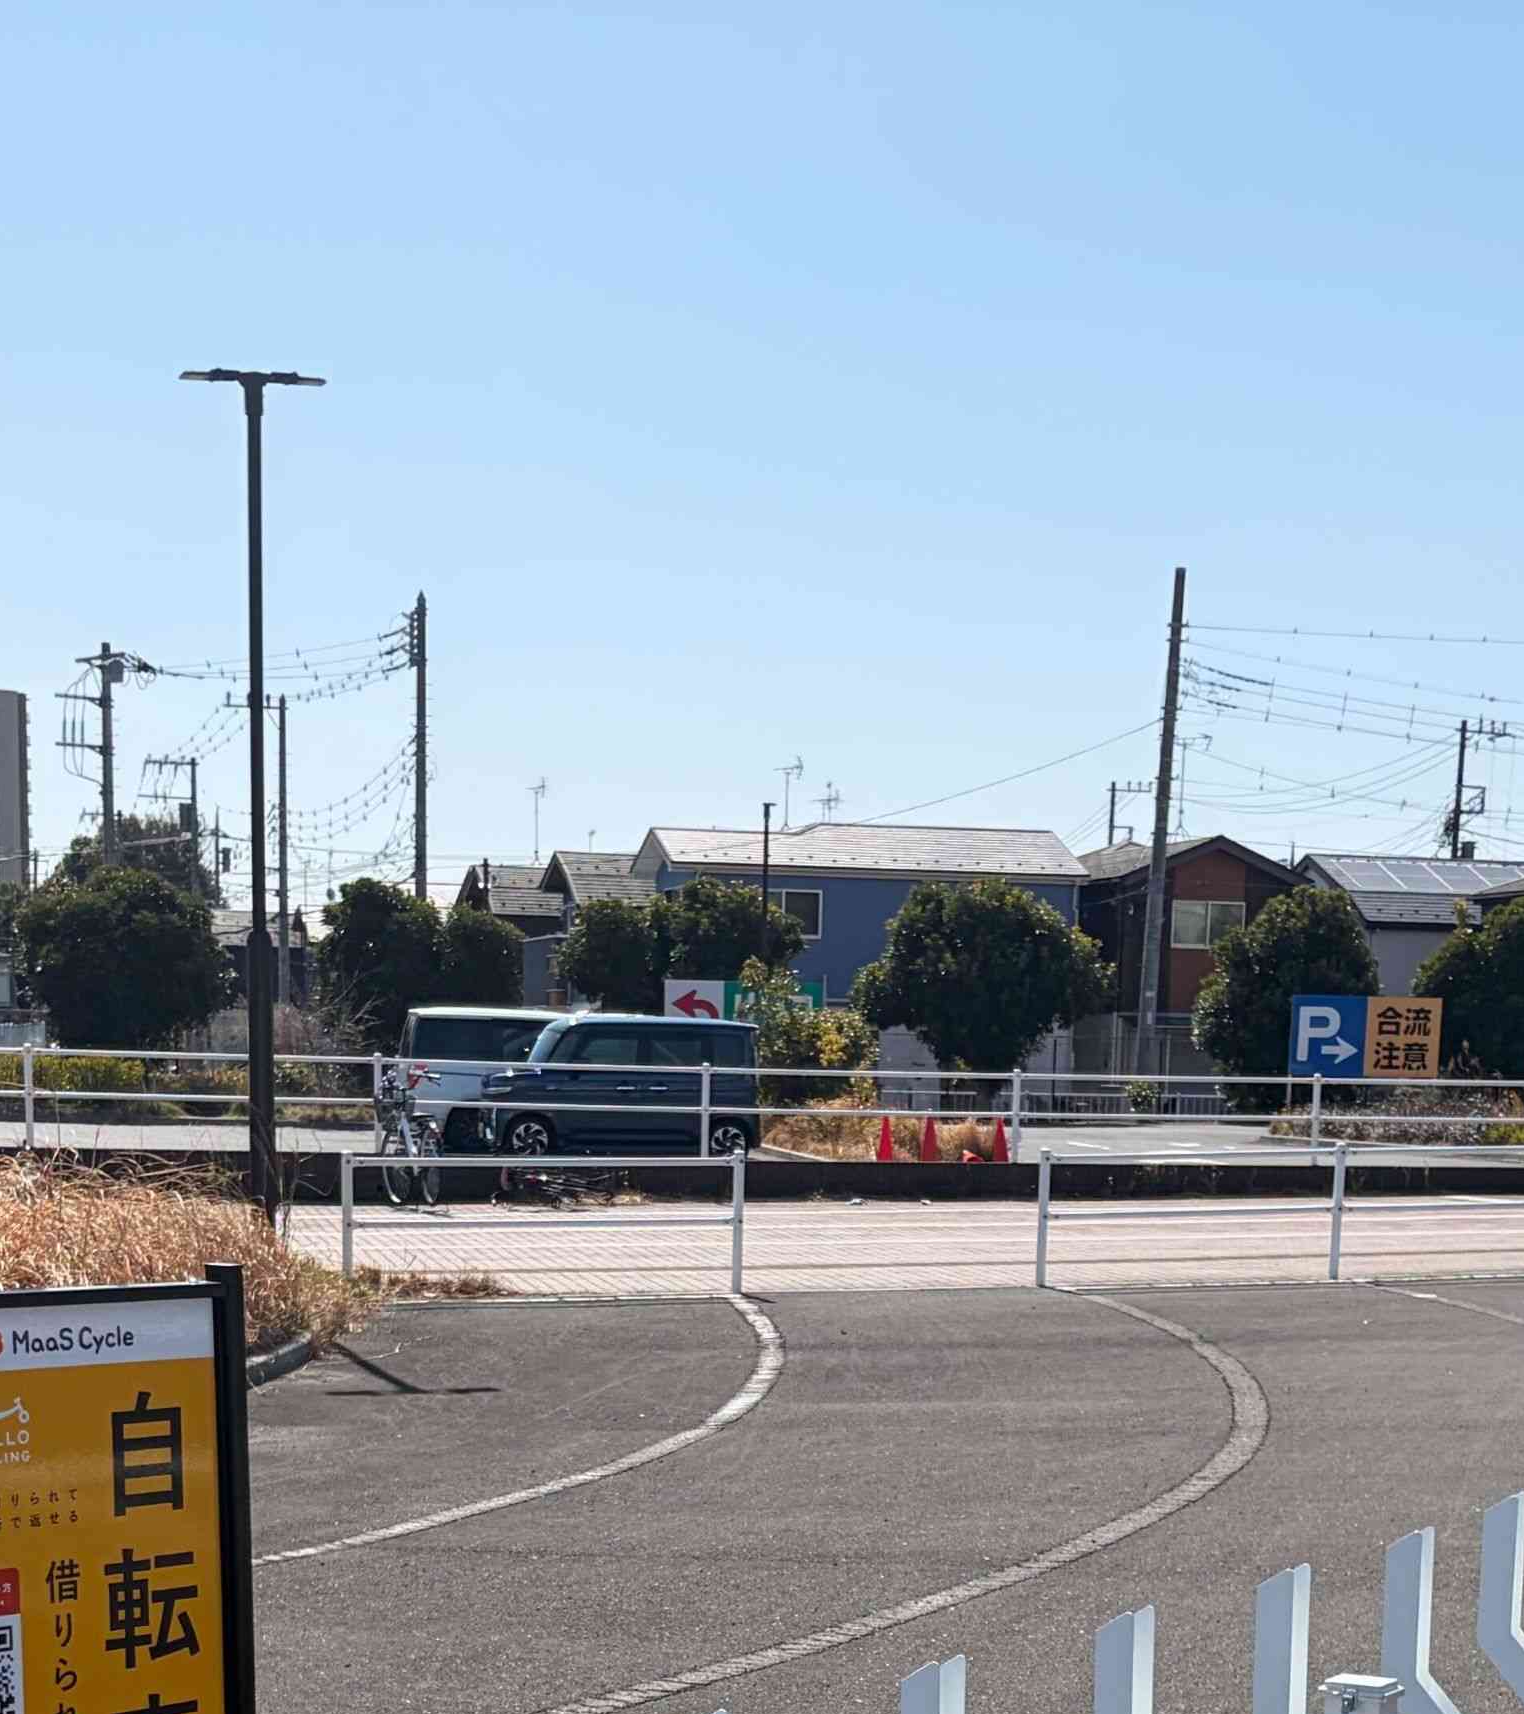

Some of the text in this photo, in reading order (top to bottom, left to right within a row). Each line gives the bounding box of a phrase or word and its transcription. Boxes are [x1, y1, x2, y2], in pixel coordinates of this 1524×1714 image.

[1296, 1006, 1341, 1062] P
[1377, 1006, 1432, 1036] 合流
[1373, 1042, 1429, 1071] 注意
[12, 1325, 135, 1355] MaaS Cycle
